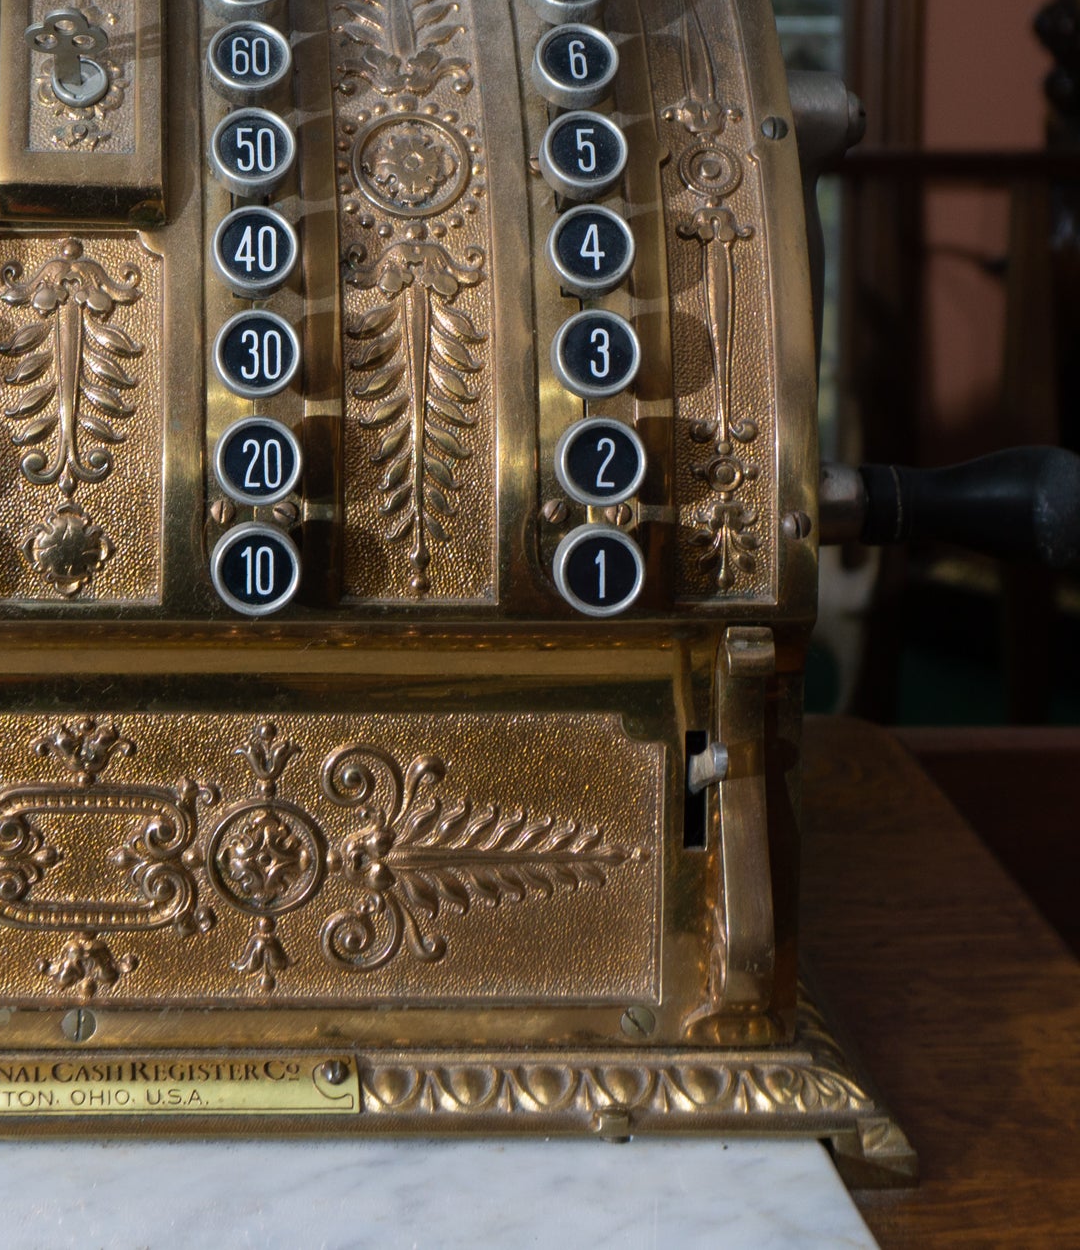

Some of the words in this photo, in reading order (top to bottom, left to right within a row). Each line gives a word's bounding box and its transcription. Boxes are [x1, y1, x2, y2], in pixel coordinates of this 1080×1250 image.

[231, 36, 269, 76] 60
[568, 40, 587, 79] 6
[236, 127, 276, 172] 50
[576, 128, 596, 172] 5
[234, 225, 277, 272] 40
[580, 224, 605, 270] 4
[241, 329, 281, 379] 30
[590, 328, 609, 377] 3
[242, 439, 282, 488] 20
[596, 438, 615, 488] 2
[240, 546, 274, 595] 10
[595, 550, 605, 598] 1
[51, 1062, 122, 1083] CASH
[130, 1061, 259, 1082] REGISTER
[146, 1088, 209, 1106] U.S.A.
